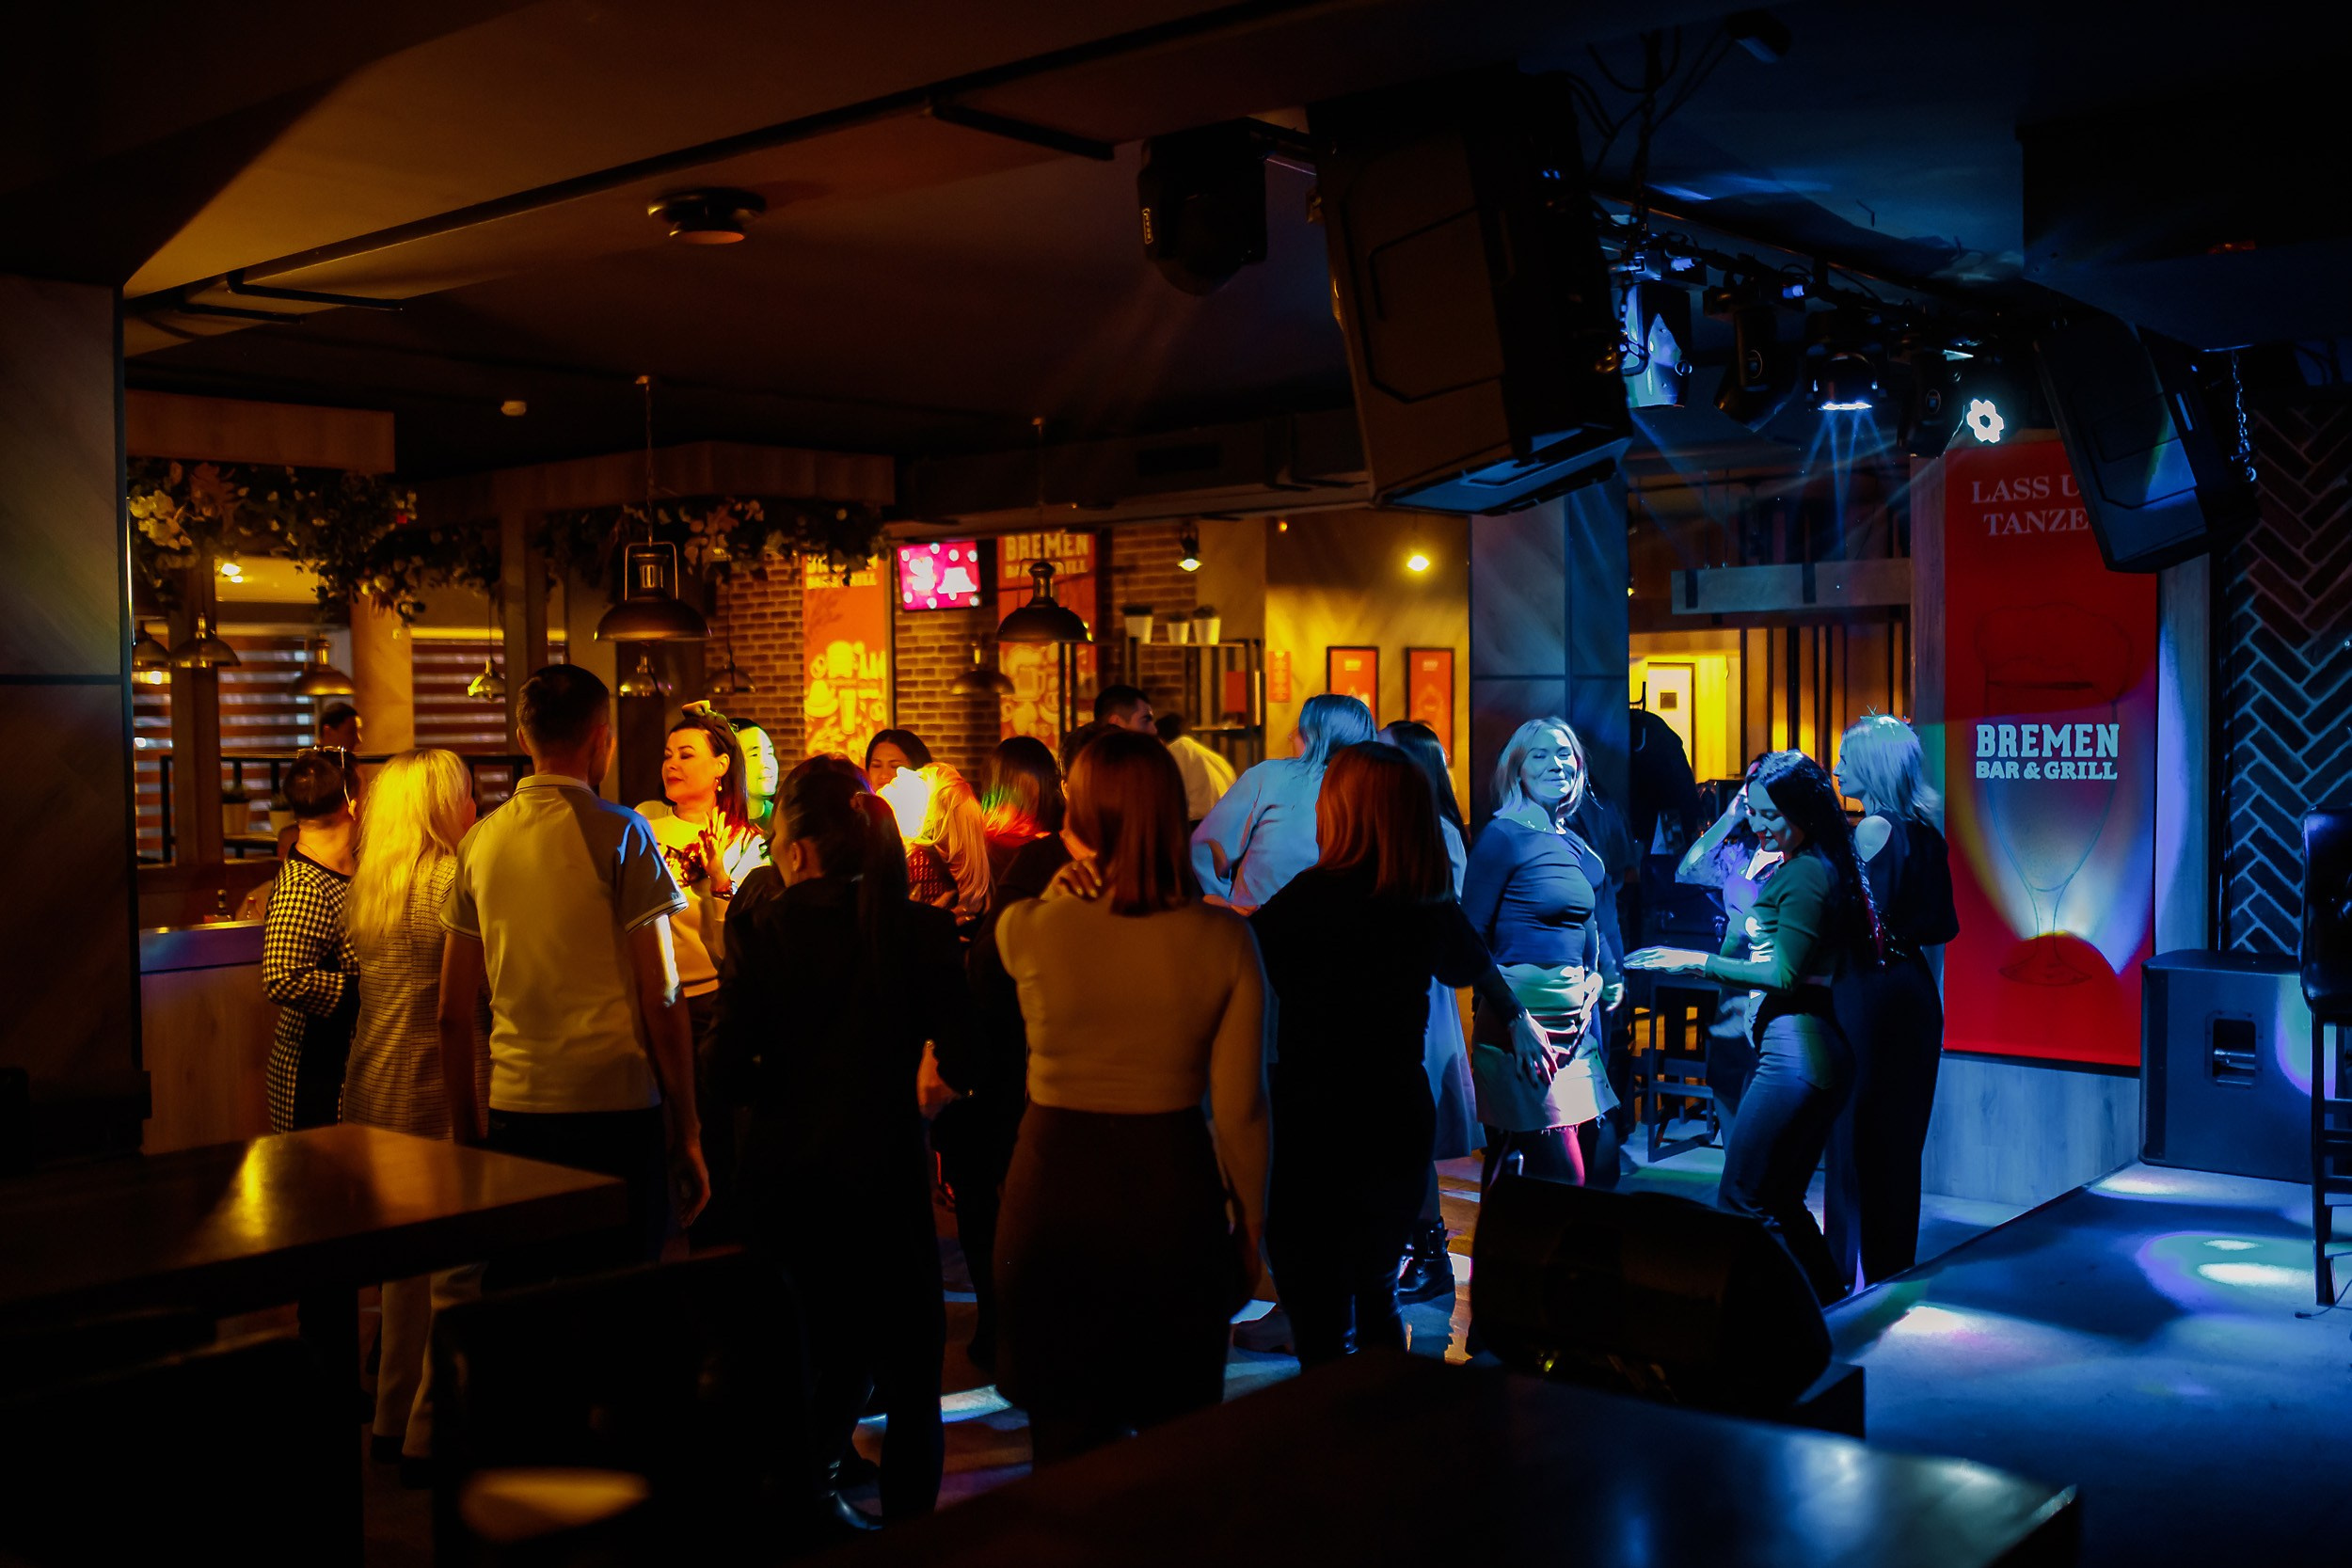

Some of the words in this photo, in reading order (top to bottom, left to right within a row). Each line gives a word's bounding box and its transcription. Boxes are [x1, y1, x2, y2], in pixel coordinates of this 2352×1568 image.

[1971, 475, 2051, 504] LASS
[2059, 473, 2080, 498] U
[1982, 507, 2090, 537] TANZE
[1004, 531, 1089, 562] BREMEN
[1976, 722, 2120, 758] BREMEN
[1976, 760, 2020, 780] BAR
[2023, 761, 2042, 780] &
[2043, 761, 2118, 781] GRILL
